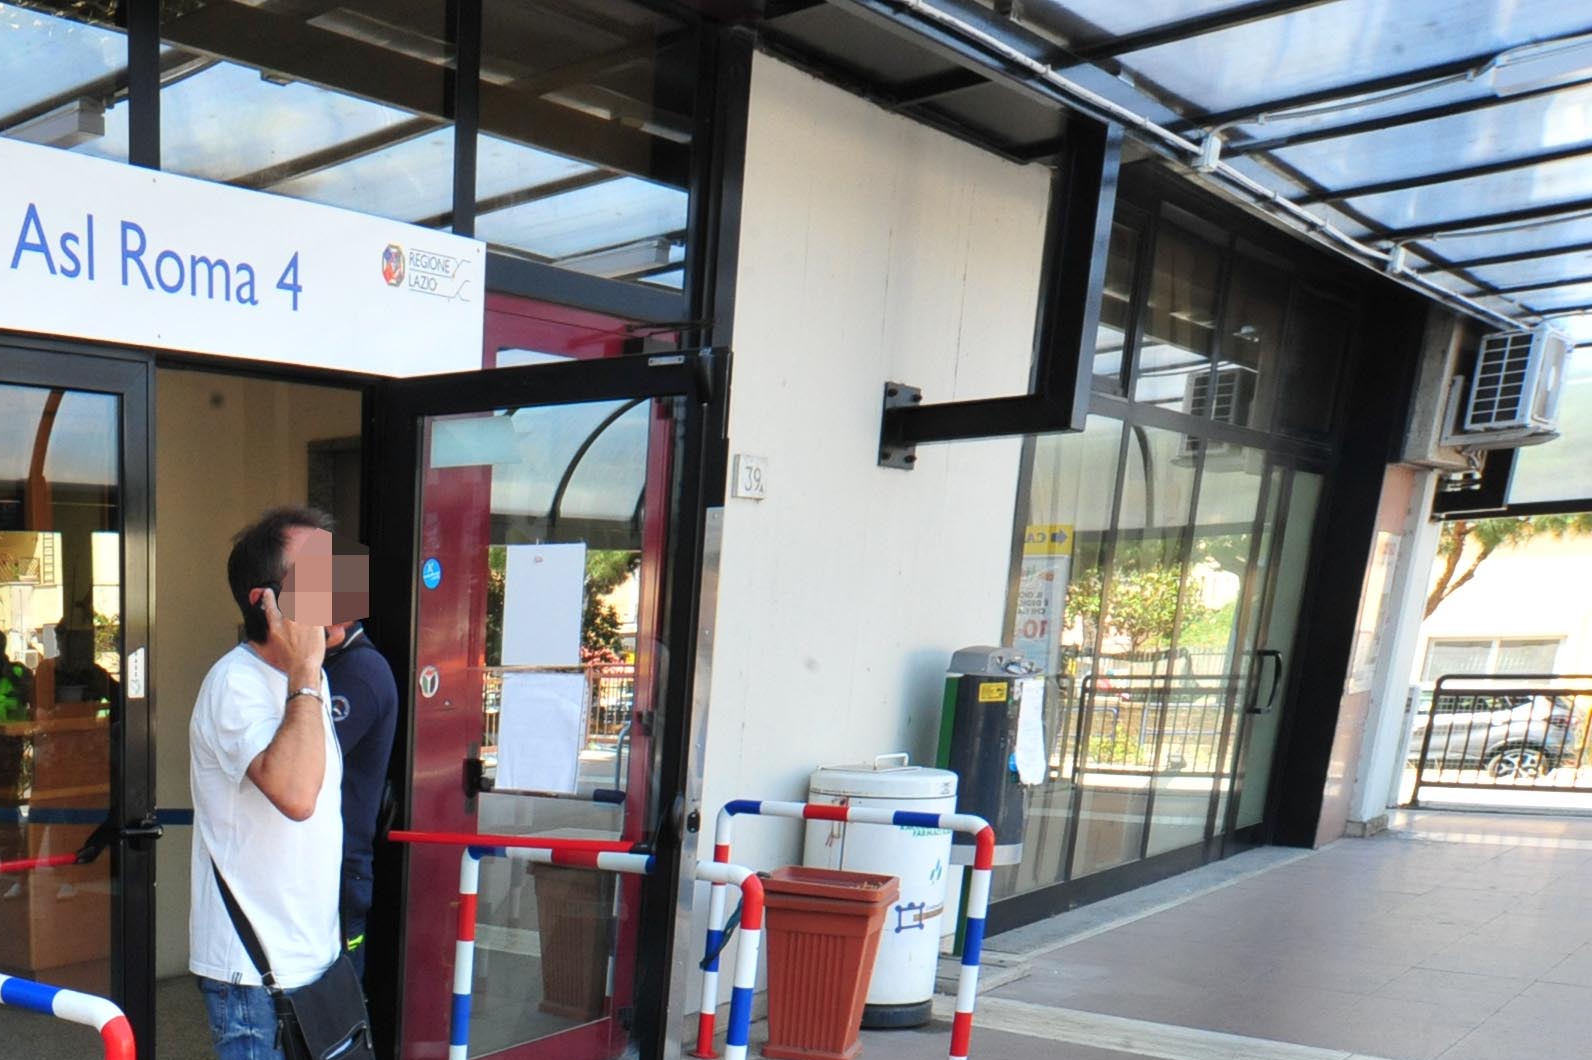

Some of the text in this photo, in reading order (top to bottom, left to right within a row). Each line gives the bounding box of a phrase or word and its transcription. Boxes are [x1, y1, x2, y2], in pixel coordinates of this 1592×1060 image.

[10, 202, 303, 312] Asl Roma 4
[408, 251, 451, 274] REGIONE
[408, 272, 438, 292] LAZIO
